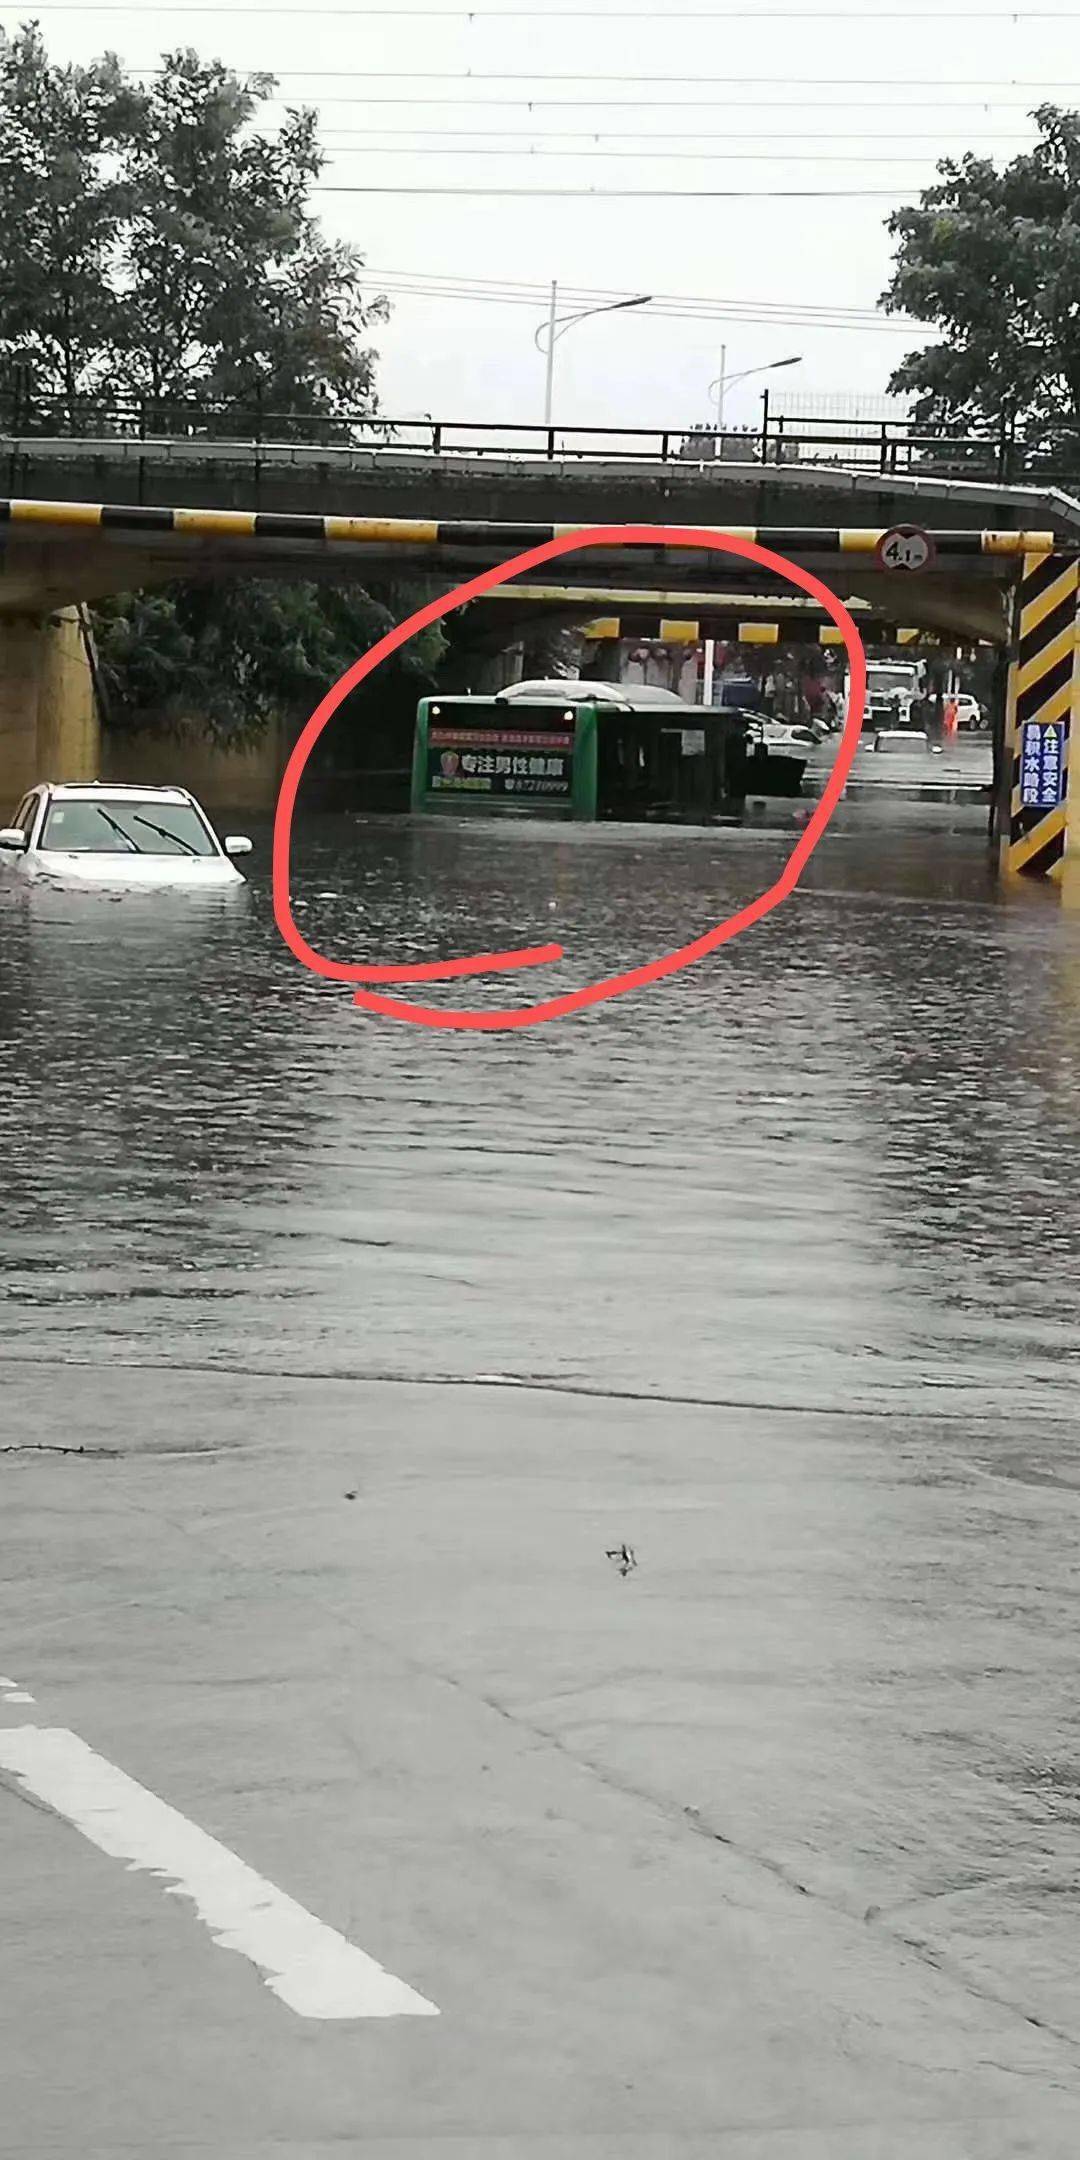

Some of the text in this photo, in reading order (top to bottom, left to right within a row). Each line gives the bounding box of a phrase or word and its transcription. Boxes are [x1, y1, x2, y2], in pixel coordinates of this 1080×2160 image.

[461, 754, 564, 776] 专注男性健康
[1023, 724, 1041, 804] 易积水路段
[1041, 739, 1059, 803] 注意安全
